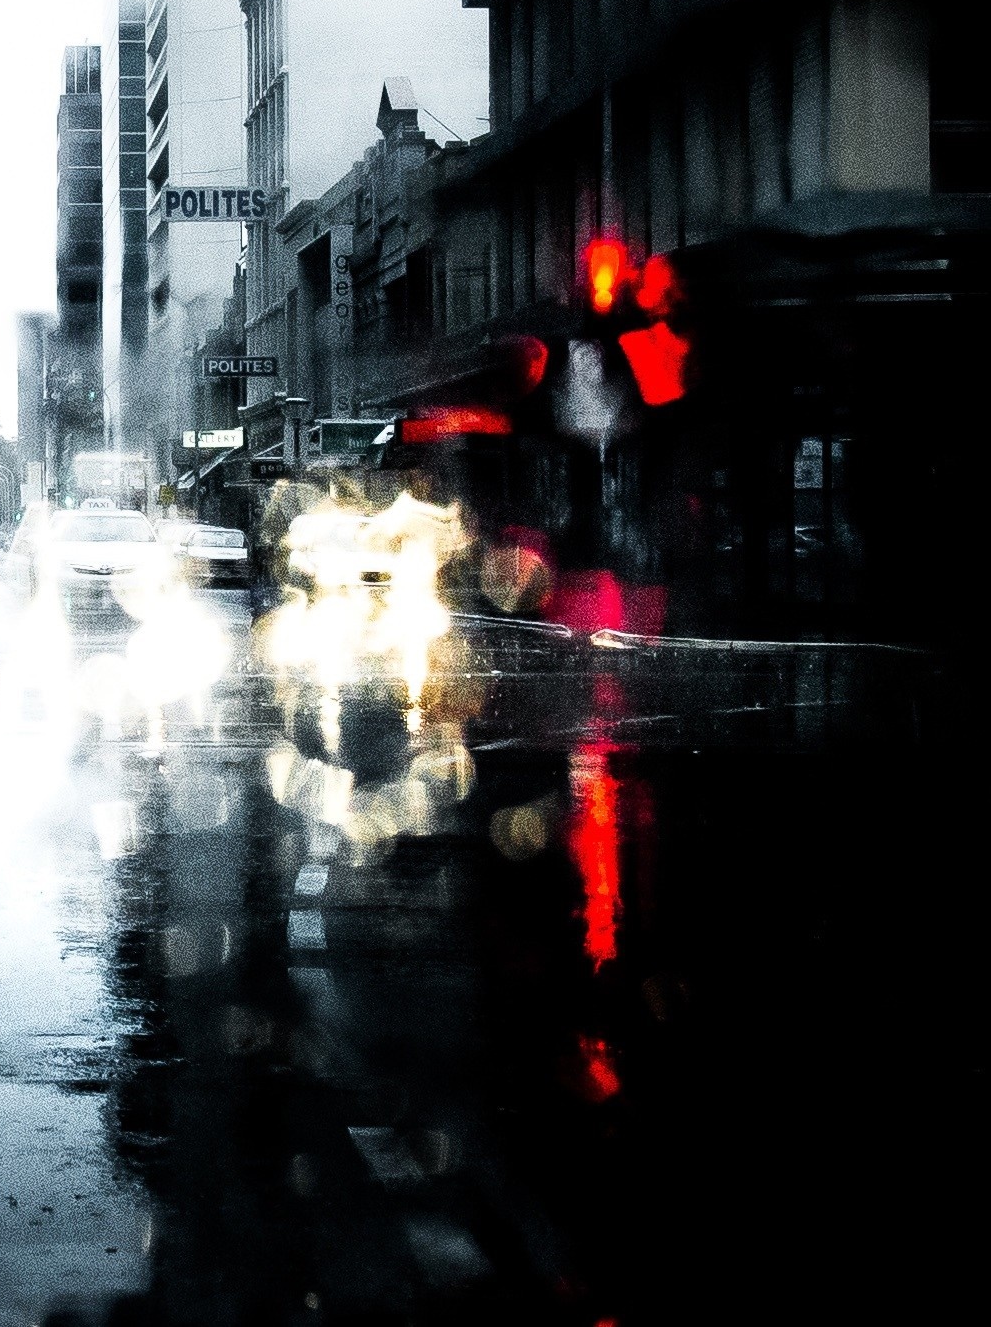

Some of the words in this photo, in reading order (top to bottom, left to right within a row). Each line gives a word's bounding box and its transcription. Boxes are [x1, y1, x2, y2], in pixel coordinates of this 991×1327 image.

[165, 189, 266, 218] POLITES
[208, 360, 273, 373] POLITES
[188, 434, 236, 444] GLLERY
[85, 501, 110, 509] TAXI
